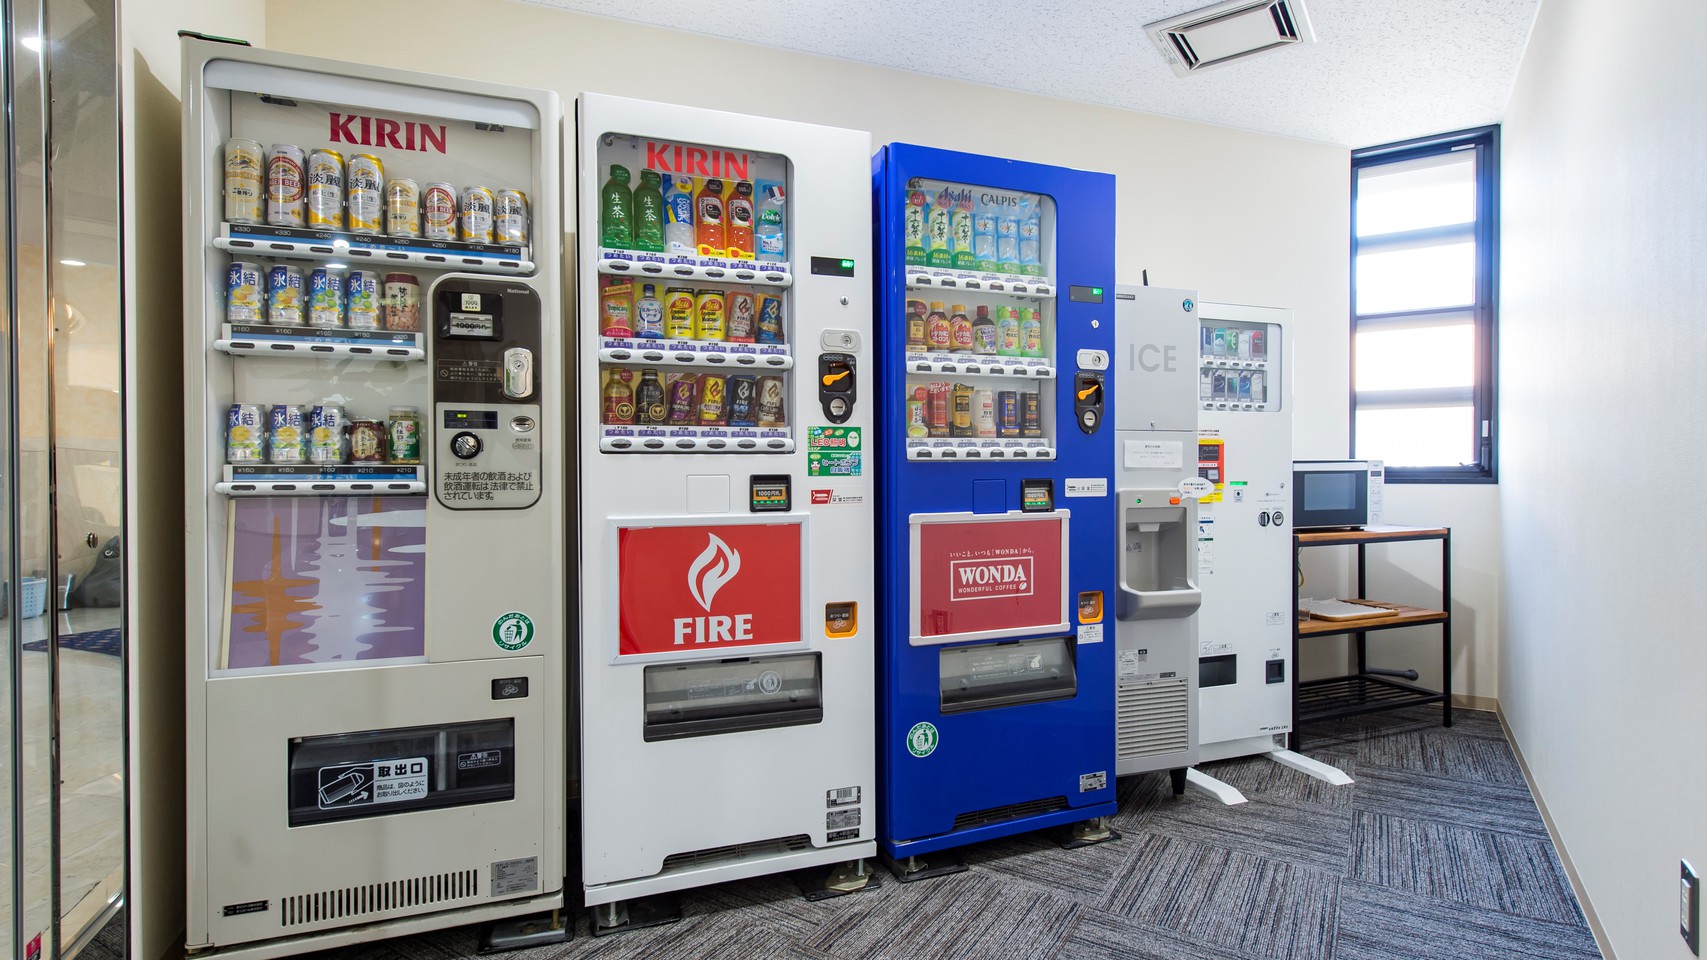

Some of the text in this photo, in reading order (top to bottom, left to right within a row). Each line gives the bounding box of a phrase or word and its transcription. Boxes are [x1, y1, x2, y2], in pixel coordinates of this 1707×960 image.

[329, 112, 447, 155] KIRIN
[646, 141, 748, 181] KIRIN
[310, 173, 341, 187] 淡麗
[349, 178, 380, 192] 淡麗
[938, 186, 1017, 207] Asahi CALPIS
[464, 202, 490, 214] 淡麗
[497, 205, 522, 216] 淡麗
[611, 192, 625, 218] 生茶
[644, 195, 657, 222] 生茶
[910, 208, 920, 239] 十六茶
[936, 210, 947, 242] 十六茶
[961, 213, 970, 244] 十六茶
[229, 271, 256, 285] 氷結
[274, 272, 300, 288] 氷結
[314, 276, 339, 291] 氷結
[350, 279, 375, 293] 氷結
[1129, 343, 1177, 373] ICE
[229, 412, 254, 426] 氷結
[274, 412, 300, 427] 氷結
[311, 413, 335, 427] 氷結
[444, 471, 532, 481] 未成年者の飲酒および
[443, 481, 534, 491] 飲酒運転は法律で禁止
[443, 491, 494, 501] されています。
[958, 563, 1027, 585] WONDA
[995, 583, 1017, 591] COFFEE
[673, 613, 753, 645] FIRE
[499, 640, 528, 650] リサイクル
[378, 762, 423, 778] 取出口
[376, 780, 425, 791] 商品は、図のように
[376, 787, 425, 798] お取り出しください。
